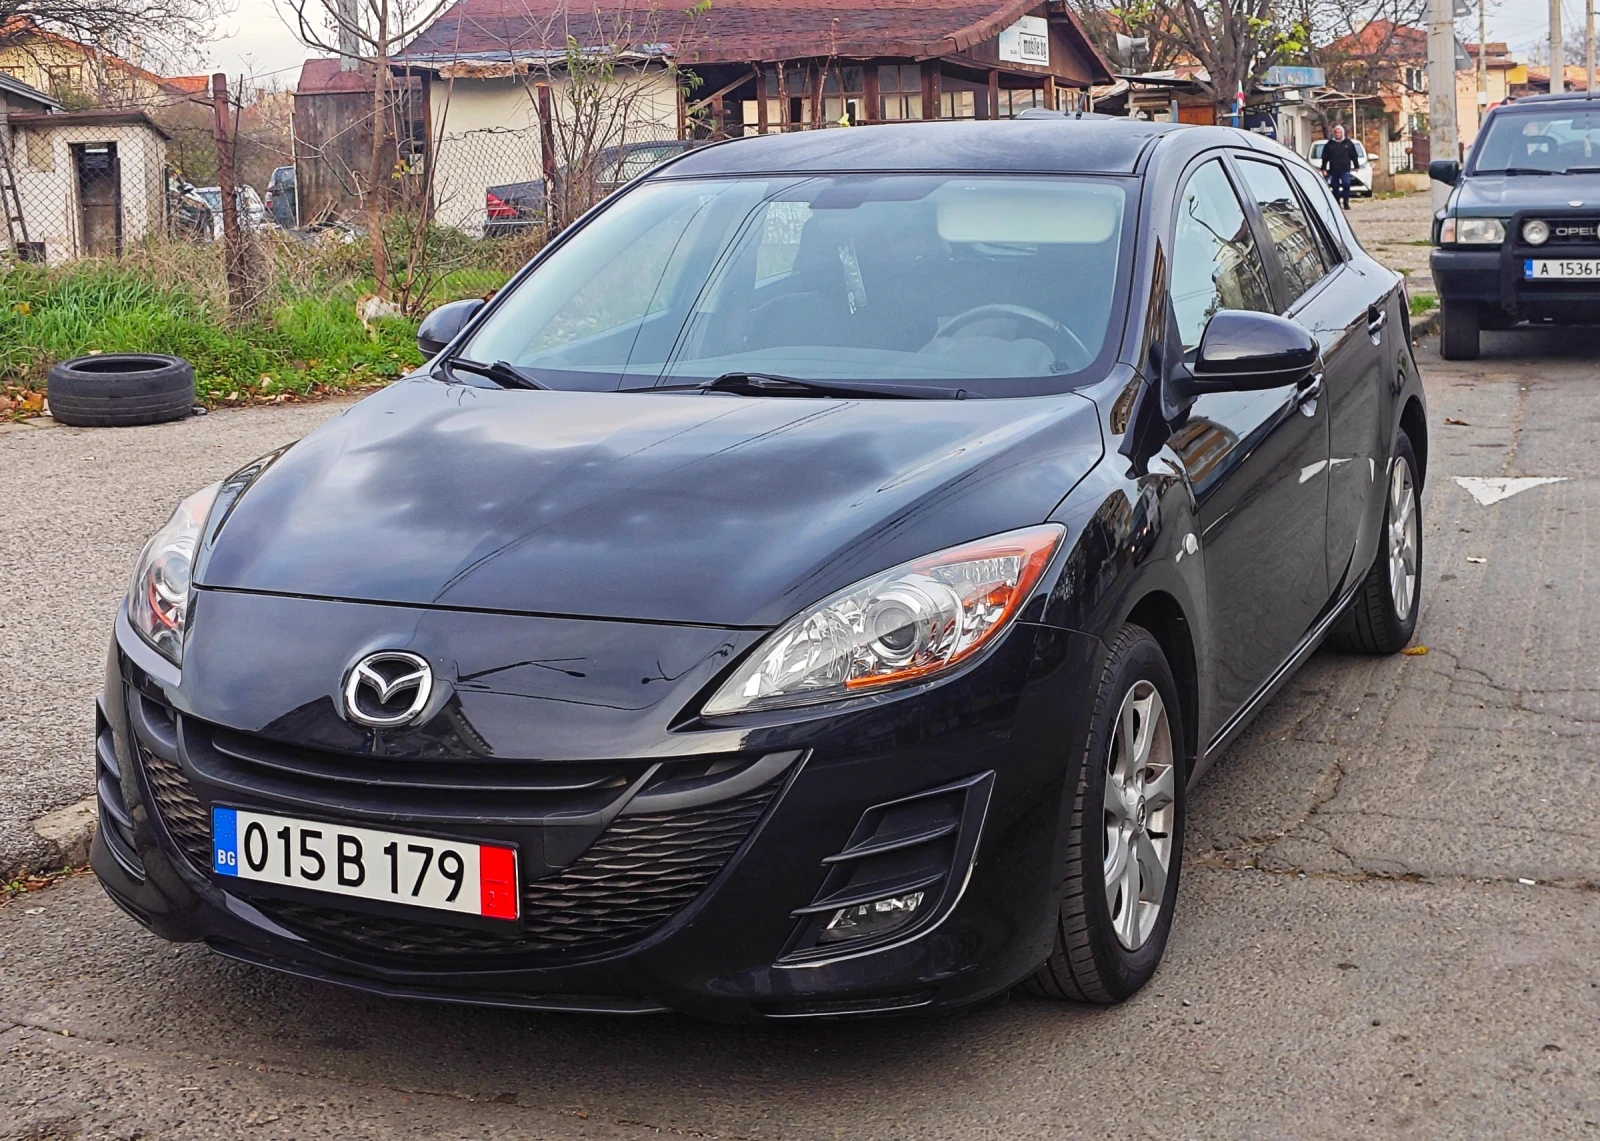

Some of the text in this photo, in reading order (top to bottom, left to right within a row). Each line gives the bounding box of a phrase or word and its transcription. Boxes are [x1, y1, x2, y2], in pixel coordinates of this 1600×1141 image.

[1556, 227, 1596, 235] OPEL
[1540, 262, 1549, 276] A
[1559, 262, 1592, 276] 1536
[217, 849, 236, 866] BG
[383, 841, 465, 902] 179
